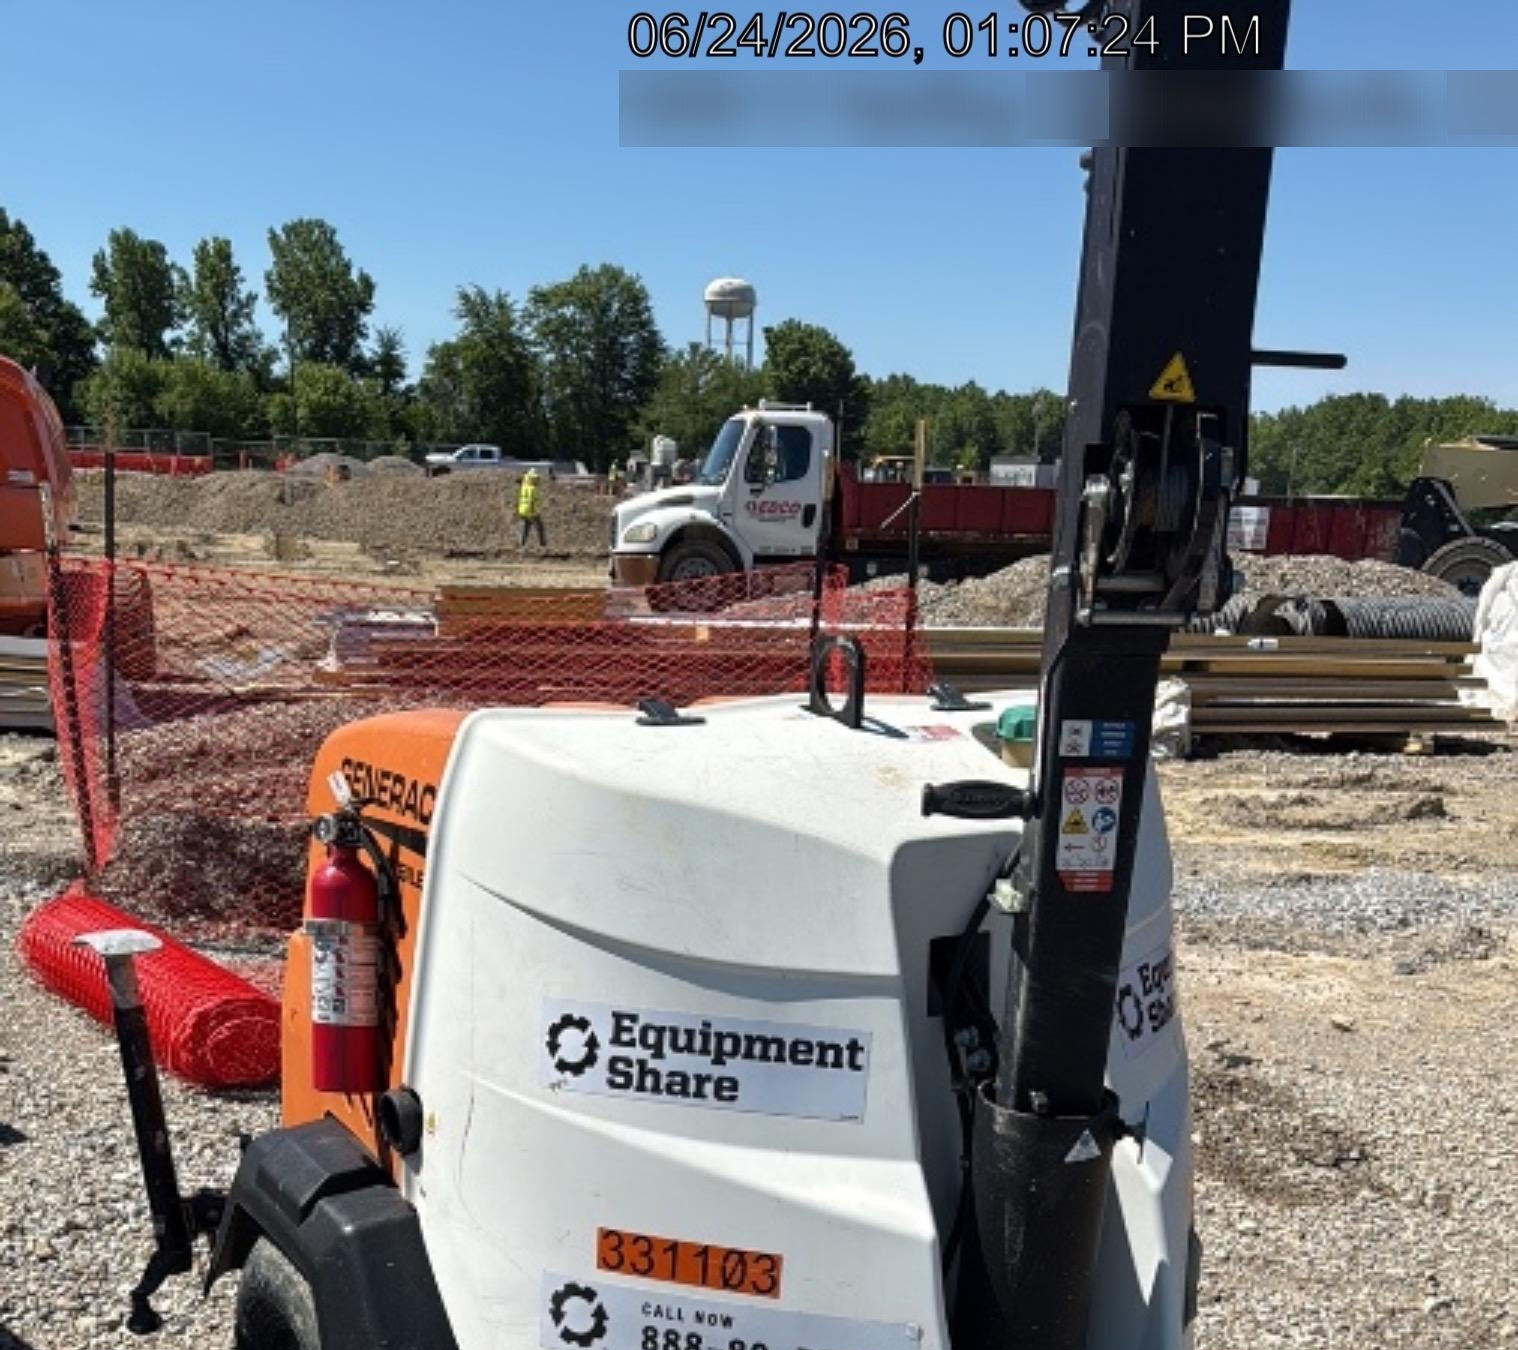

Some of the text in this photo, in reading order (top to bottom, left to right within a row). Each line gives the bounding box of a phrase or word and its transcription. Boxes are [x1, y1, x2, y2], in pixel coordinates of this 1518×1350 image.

[609, 1010, 865, 1071] Equipment
[606, 1055, 739, 1102] Share
[601, 1230, 778, 1295] 331103
[641, 1302, 736, 1329] CALL NOW
